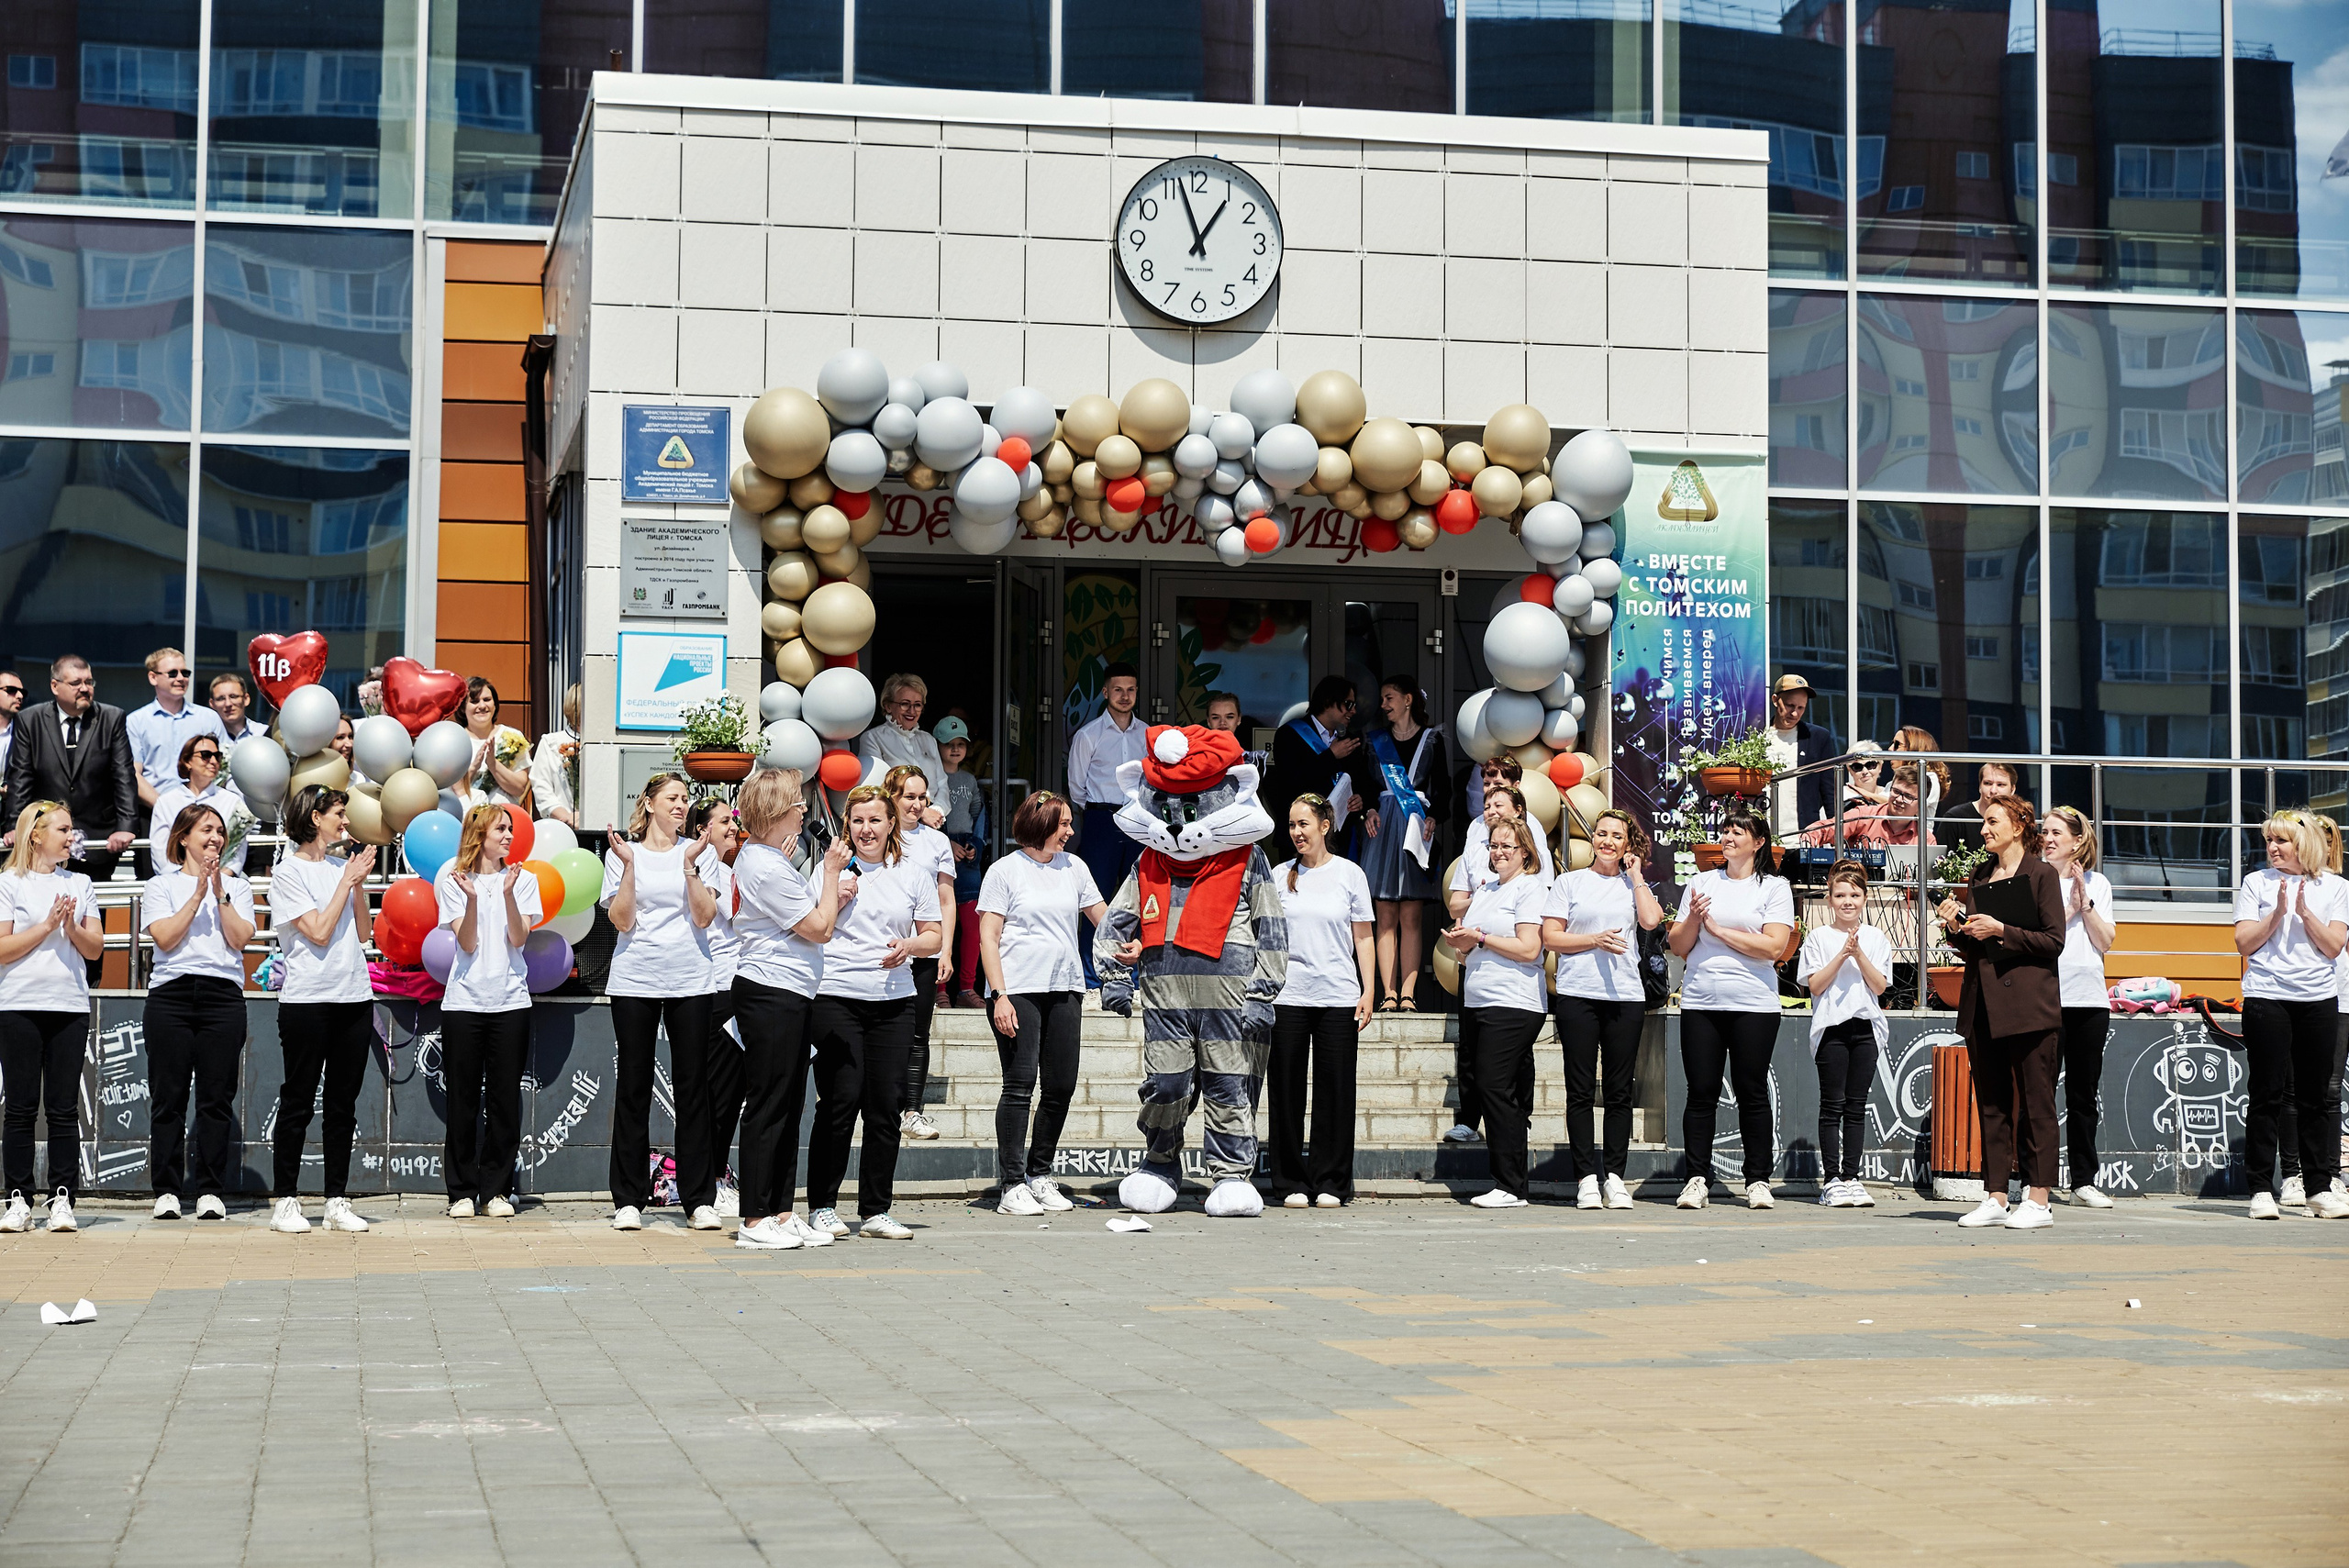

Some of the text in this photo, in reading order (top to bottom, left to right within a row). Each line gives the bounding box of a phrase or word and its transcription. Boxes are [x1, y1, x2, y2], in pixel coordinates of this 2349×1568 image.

[1162, 178, 1175, 200] 11
[1188, 170, 1208, 194] 12
[1225, 180, 1230, 202] 1
[1137, 198, 1158, 221] 10
[1242, 201, 1256, 224] 2
[1130, 229, 1146, 252] 9
[1253, 233, 1266, 256] 3
[1141, 259, 1153, 282] 8
[1242, 263, 1258, 285] 4
[1164, 282, 1180, 305] 7
[1191, 291, 1206, 313] 6
[1220, 284, 1236, 306] 5
[1648, 554, 1727, 571] ВМЕСТЕ
[1628, 576, 1748, 595] С ТОМСКИМ
[1625, 599, 1751, 618] ПОЛИТЕХОМ
[1661, 629, 1672, 690] Учимся
[1681, 629, 1693, 737] Развиваемся
[1701, 629, 1714, 739] Идем вперед
